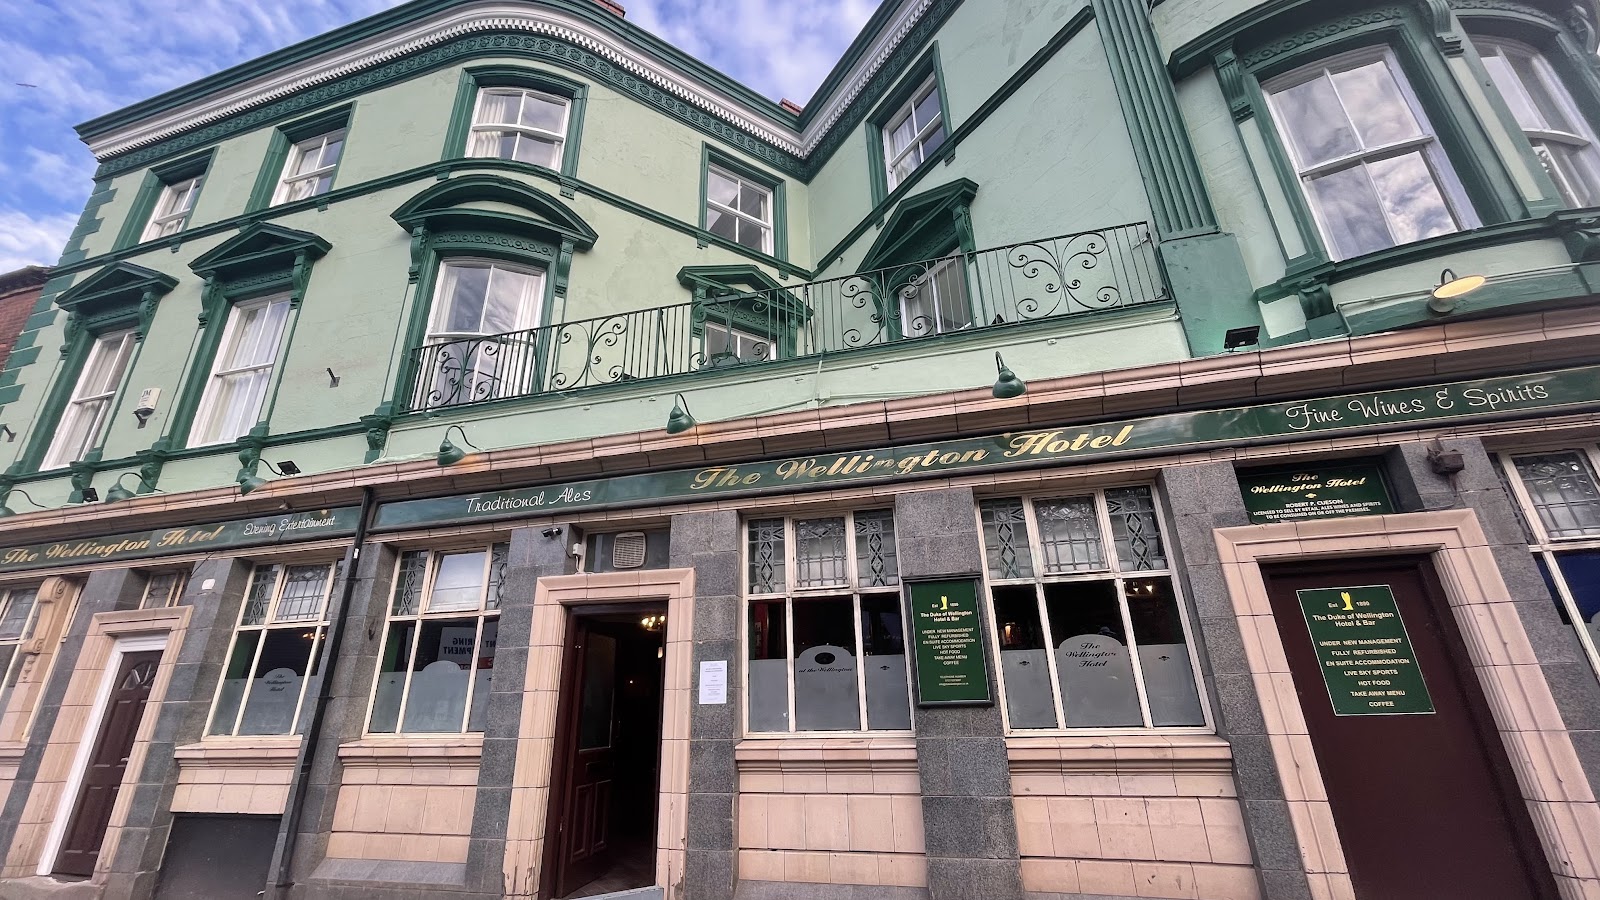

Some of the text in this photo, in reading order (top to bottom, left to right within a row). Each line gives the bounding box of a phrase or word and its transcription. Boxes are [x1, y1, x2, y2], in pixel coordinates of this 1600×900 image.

[1286, 384, 1549, 430] Fine Wines & Spirits
[690, 425, 1134, 490] The Wellington Hotel
[1292, 473, 1319, 482] The
[1251, 477, 1366, 494] Wellington Hotel
[466, 487, 592, 513] Traditional Ales
[1285, 501, 1308, 509] ROBERT
[243, 523, 277, 537] Evening
[1, 548, 39, 565] The
[46, 539, 151, 559] Wellington
[1356, 612, 1394, 620] Wellington
[1065, 651, 1117, 659] Wellington
[1079, 660, 1108, 668] Hotel
[1354, 658, 1410, 666] ACCOMMODATION
